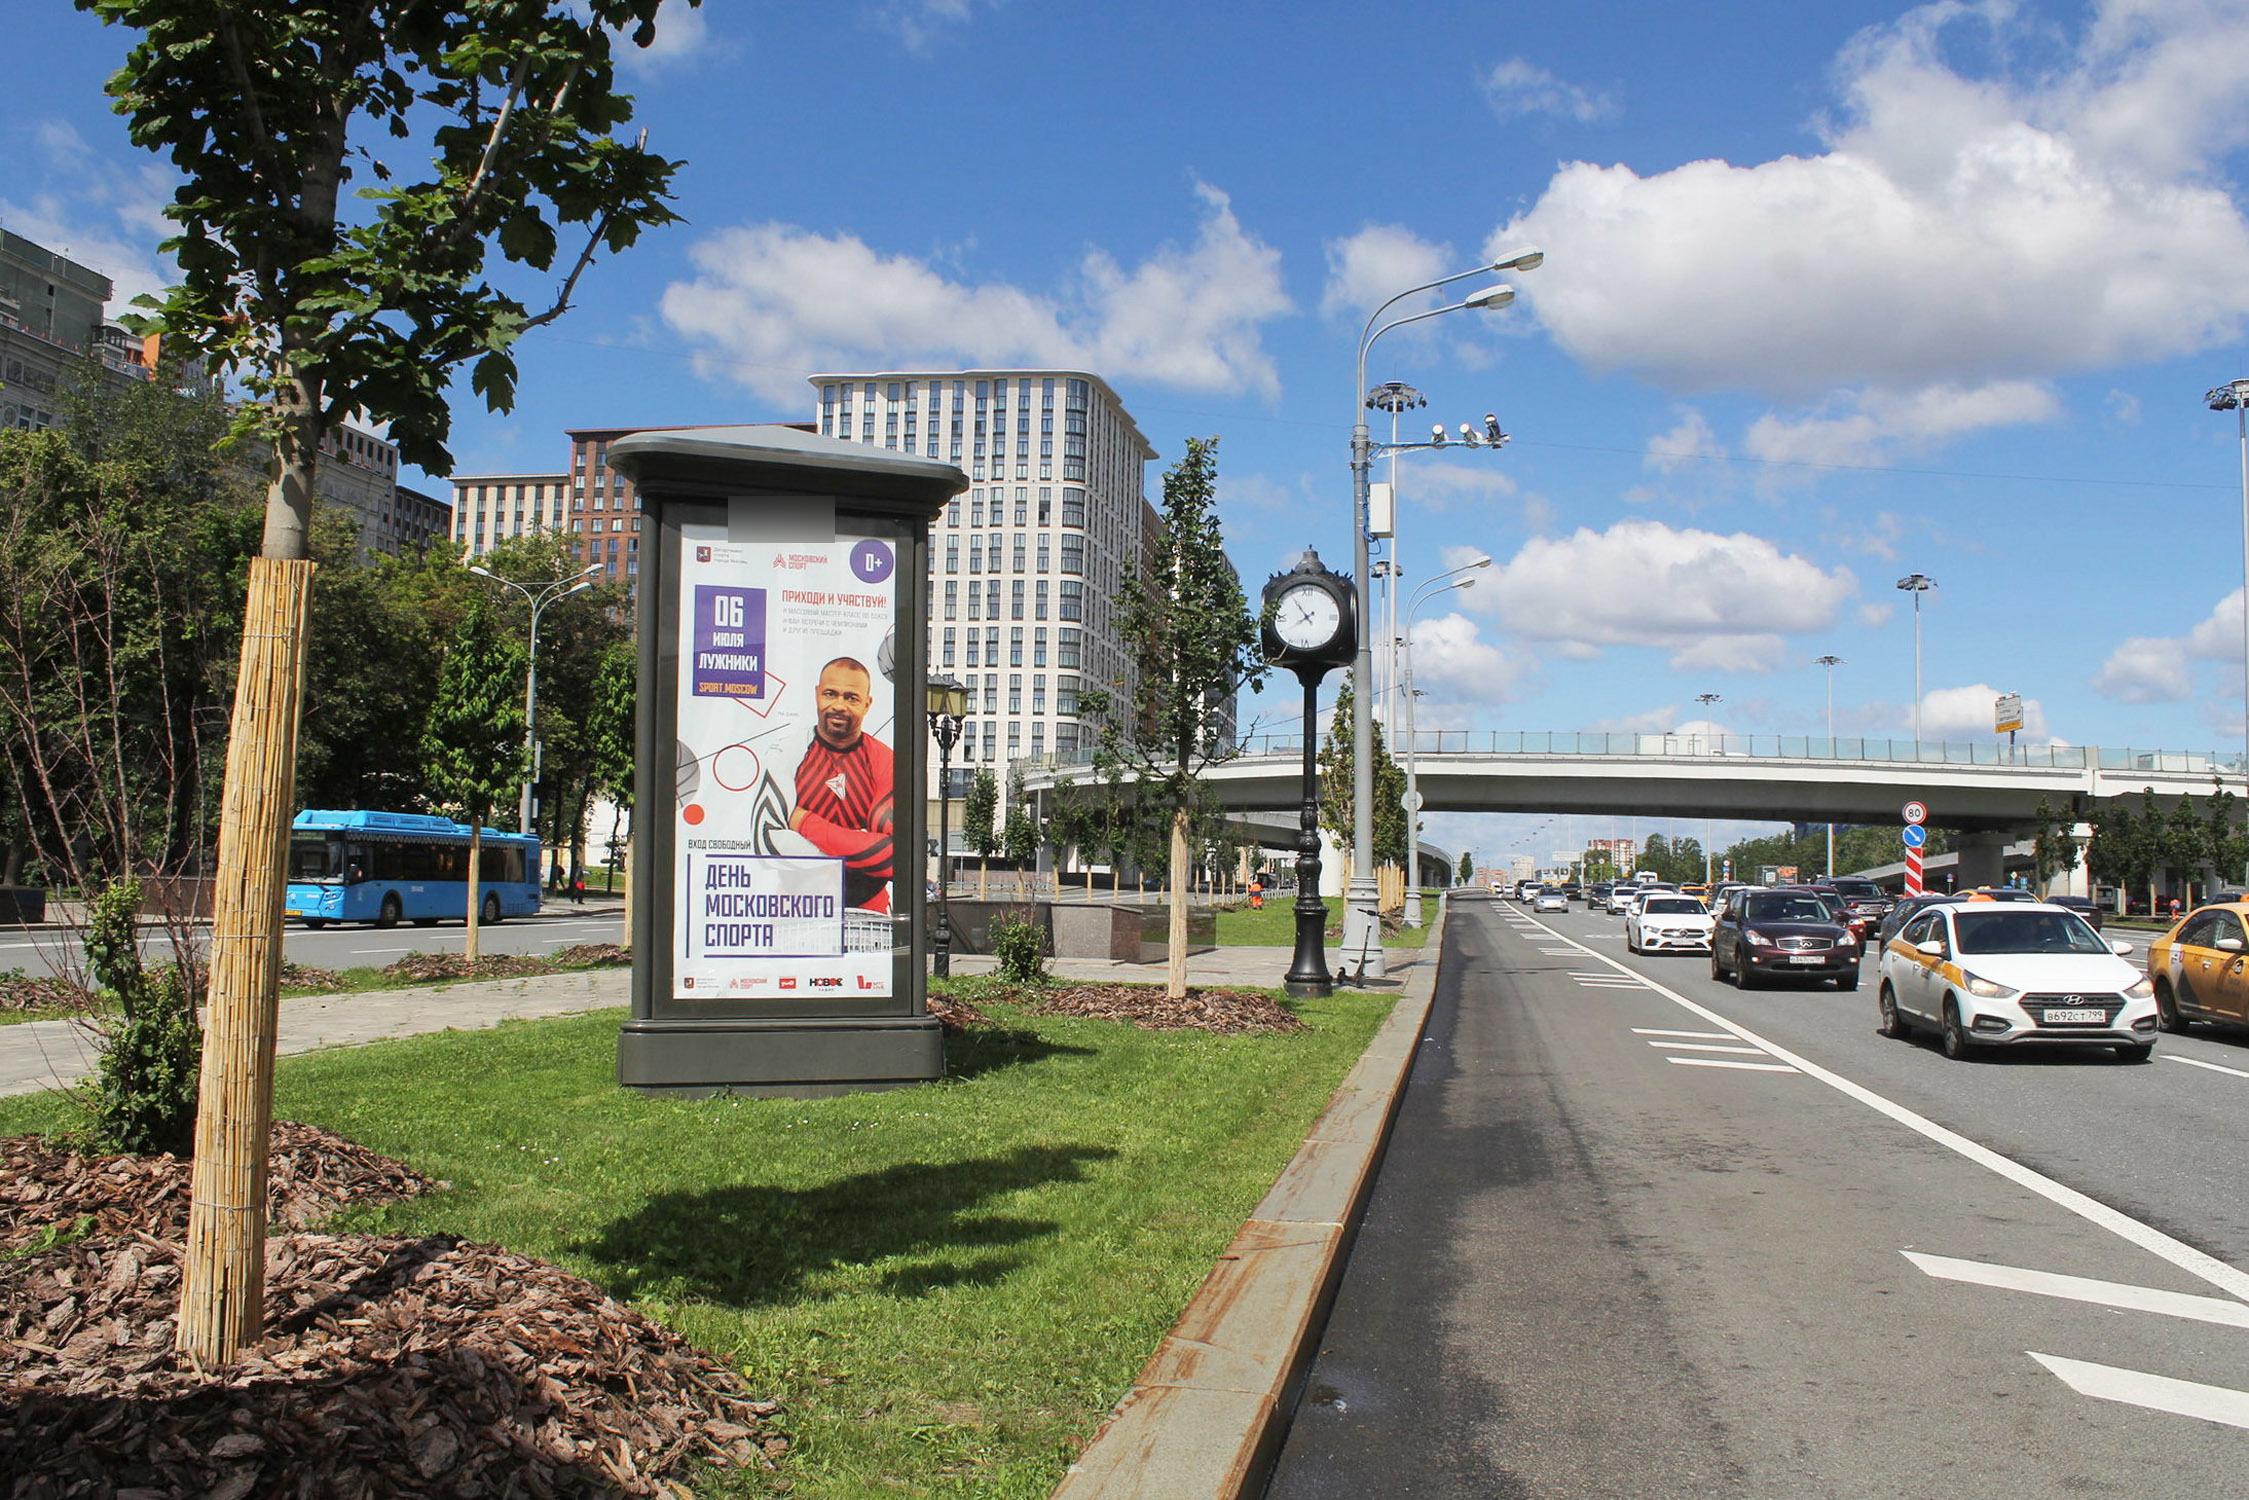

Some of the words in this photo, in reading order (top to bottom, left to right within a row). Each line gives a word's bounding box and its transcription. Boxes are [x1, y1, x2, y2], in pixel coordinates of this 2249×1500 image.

[865, 553, 883, 572] 0+
[782, 590, 825, 605] ПРИХОДИ
[827, 593, 835, 606] И
[837, 594, 887, 609] УЧАСТВУЙ!
[714, 595, 744, 628] 06
[712, 632, 744, 648] ИЮЛЯ
[698, 652, 758, 672] ЛУЖНИКИ
[699, 682, 758, 695] SPORT.MOSCOW
[1908, 808, 1921, 817] 80
[688, 839, 707, 850] ВХОД
[708, 839, 752, 851] СВОБОДНЫЙ
[705, 864, 751, 890] ДЕНЬ
[705, 893, 834, 918] МОСКОВСКОГО
[705, 923, 774, 947] СПОРТА
